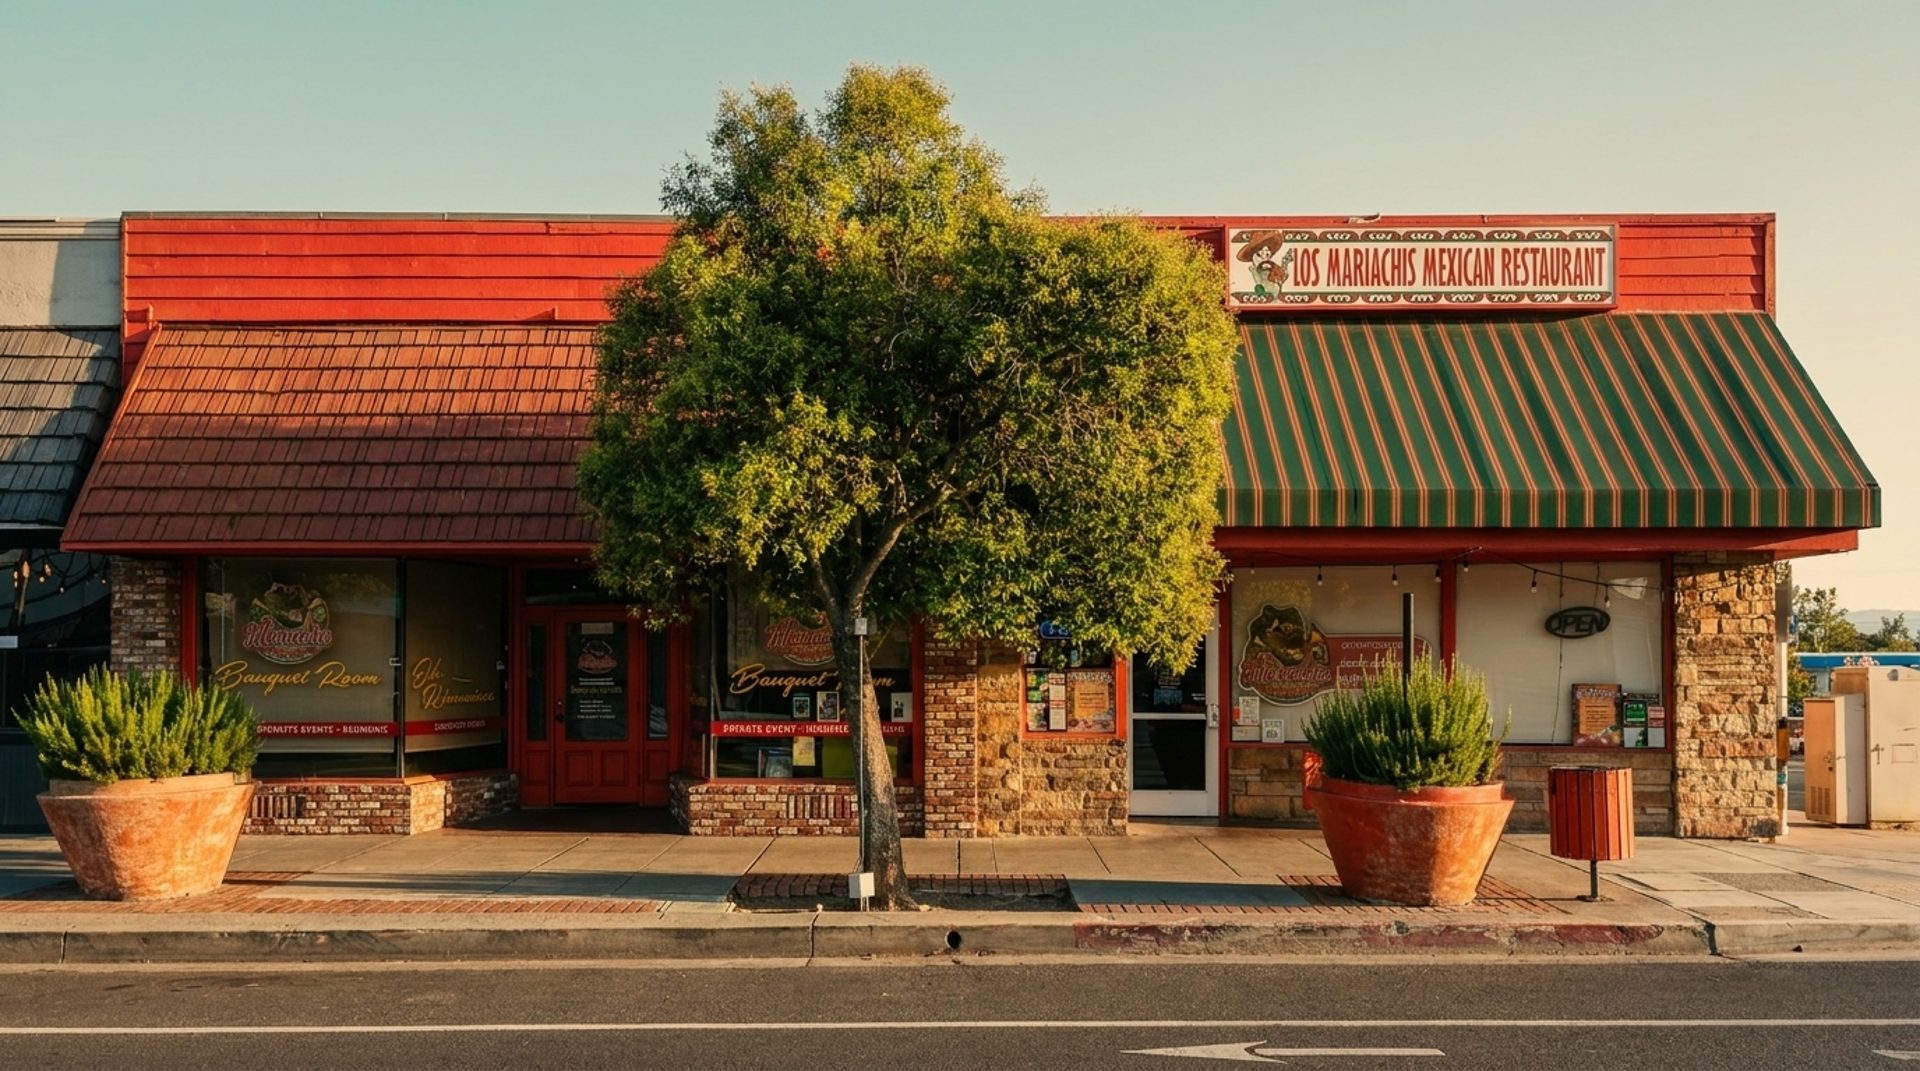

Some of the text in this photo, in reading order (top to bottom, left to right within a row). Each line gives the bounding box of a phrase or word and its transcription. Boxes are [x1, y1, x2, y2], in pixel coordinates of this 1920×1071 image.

[1293, 248, 1606, 286] LOS MARIACHIS MEXICAN RESTAURANT
[1548, 613, 1605, 634] OPEN
[314, 660, 383, 689] Room
